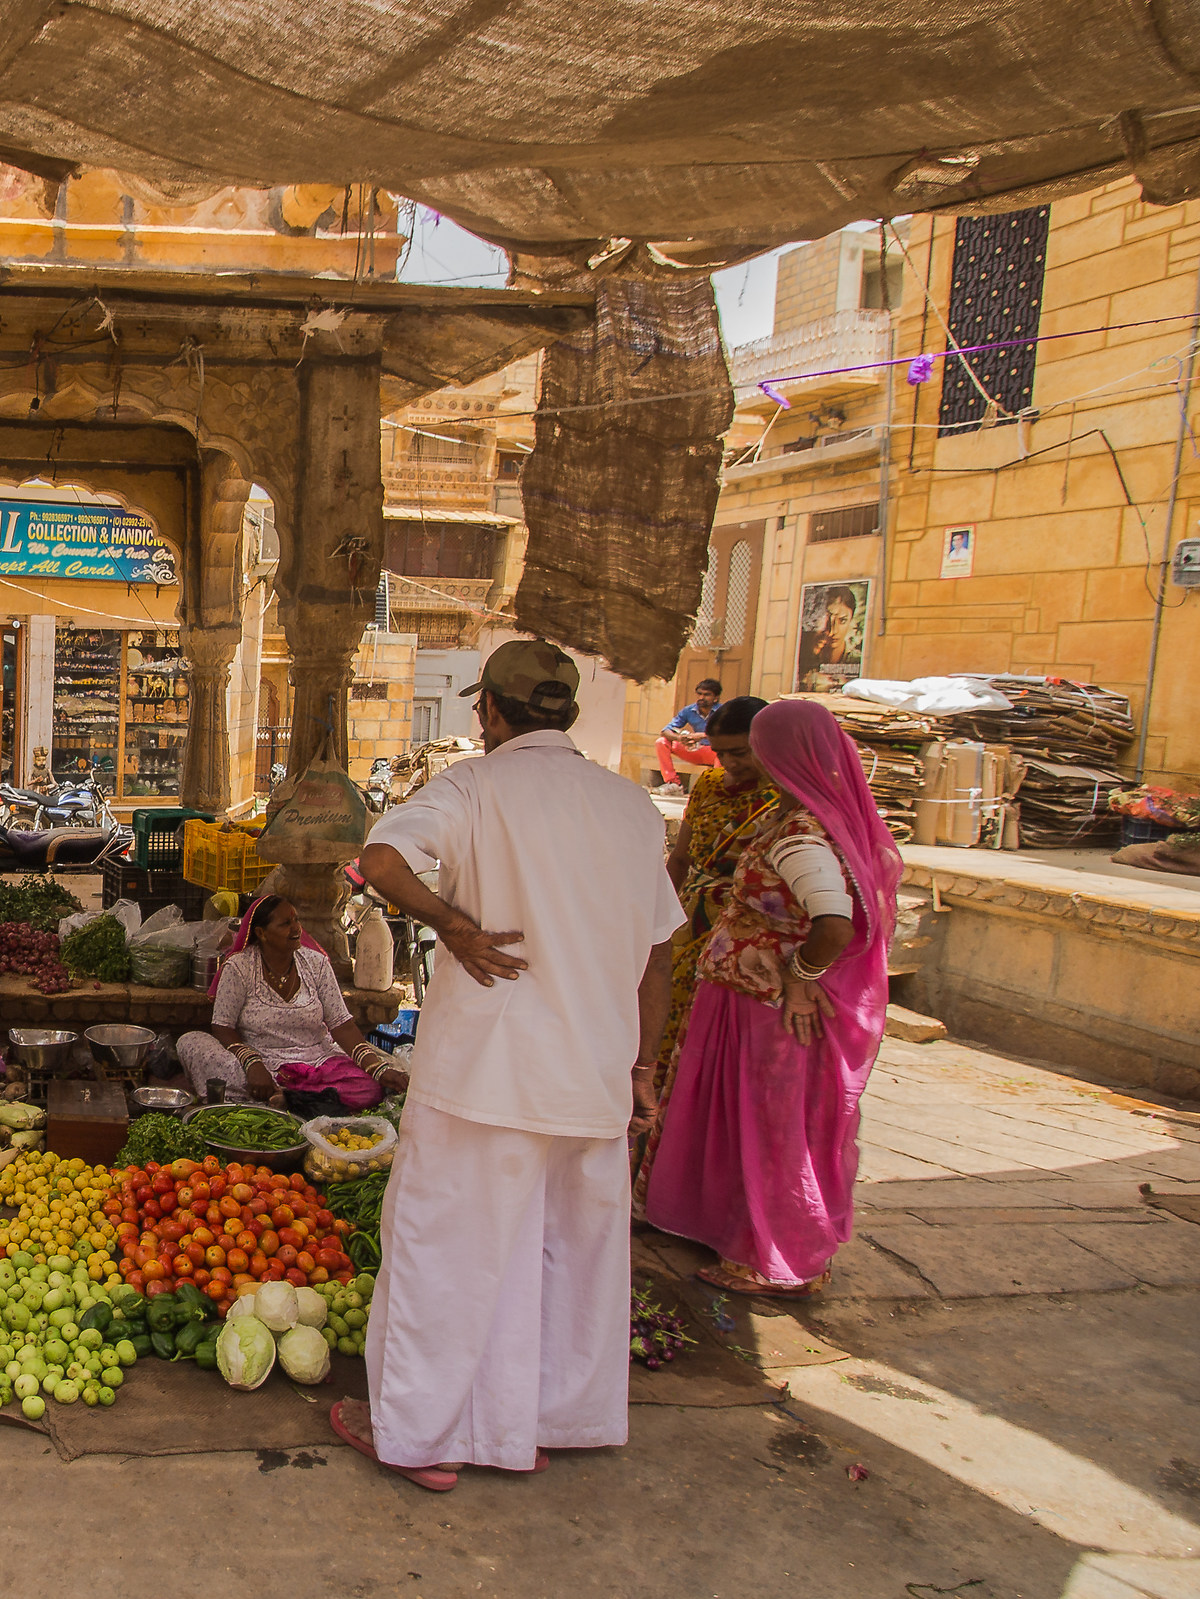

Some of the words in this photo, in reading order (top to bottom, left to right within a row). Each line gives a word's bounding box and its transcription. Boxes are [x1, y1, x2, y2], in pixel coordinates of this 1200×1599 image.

[27, 522, 97, 543] COLLECTION
[99, 526, 109, 544] &
[27, 541, 49, 556] We
[28, 559, 61, 574] All
[64, 560, 116, 577] Cards
[284, 808, 353, 827] Premium
